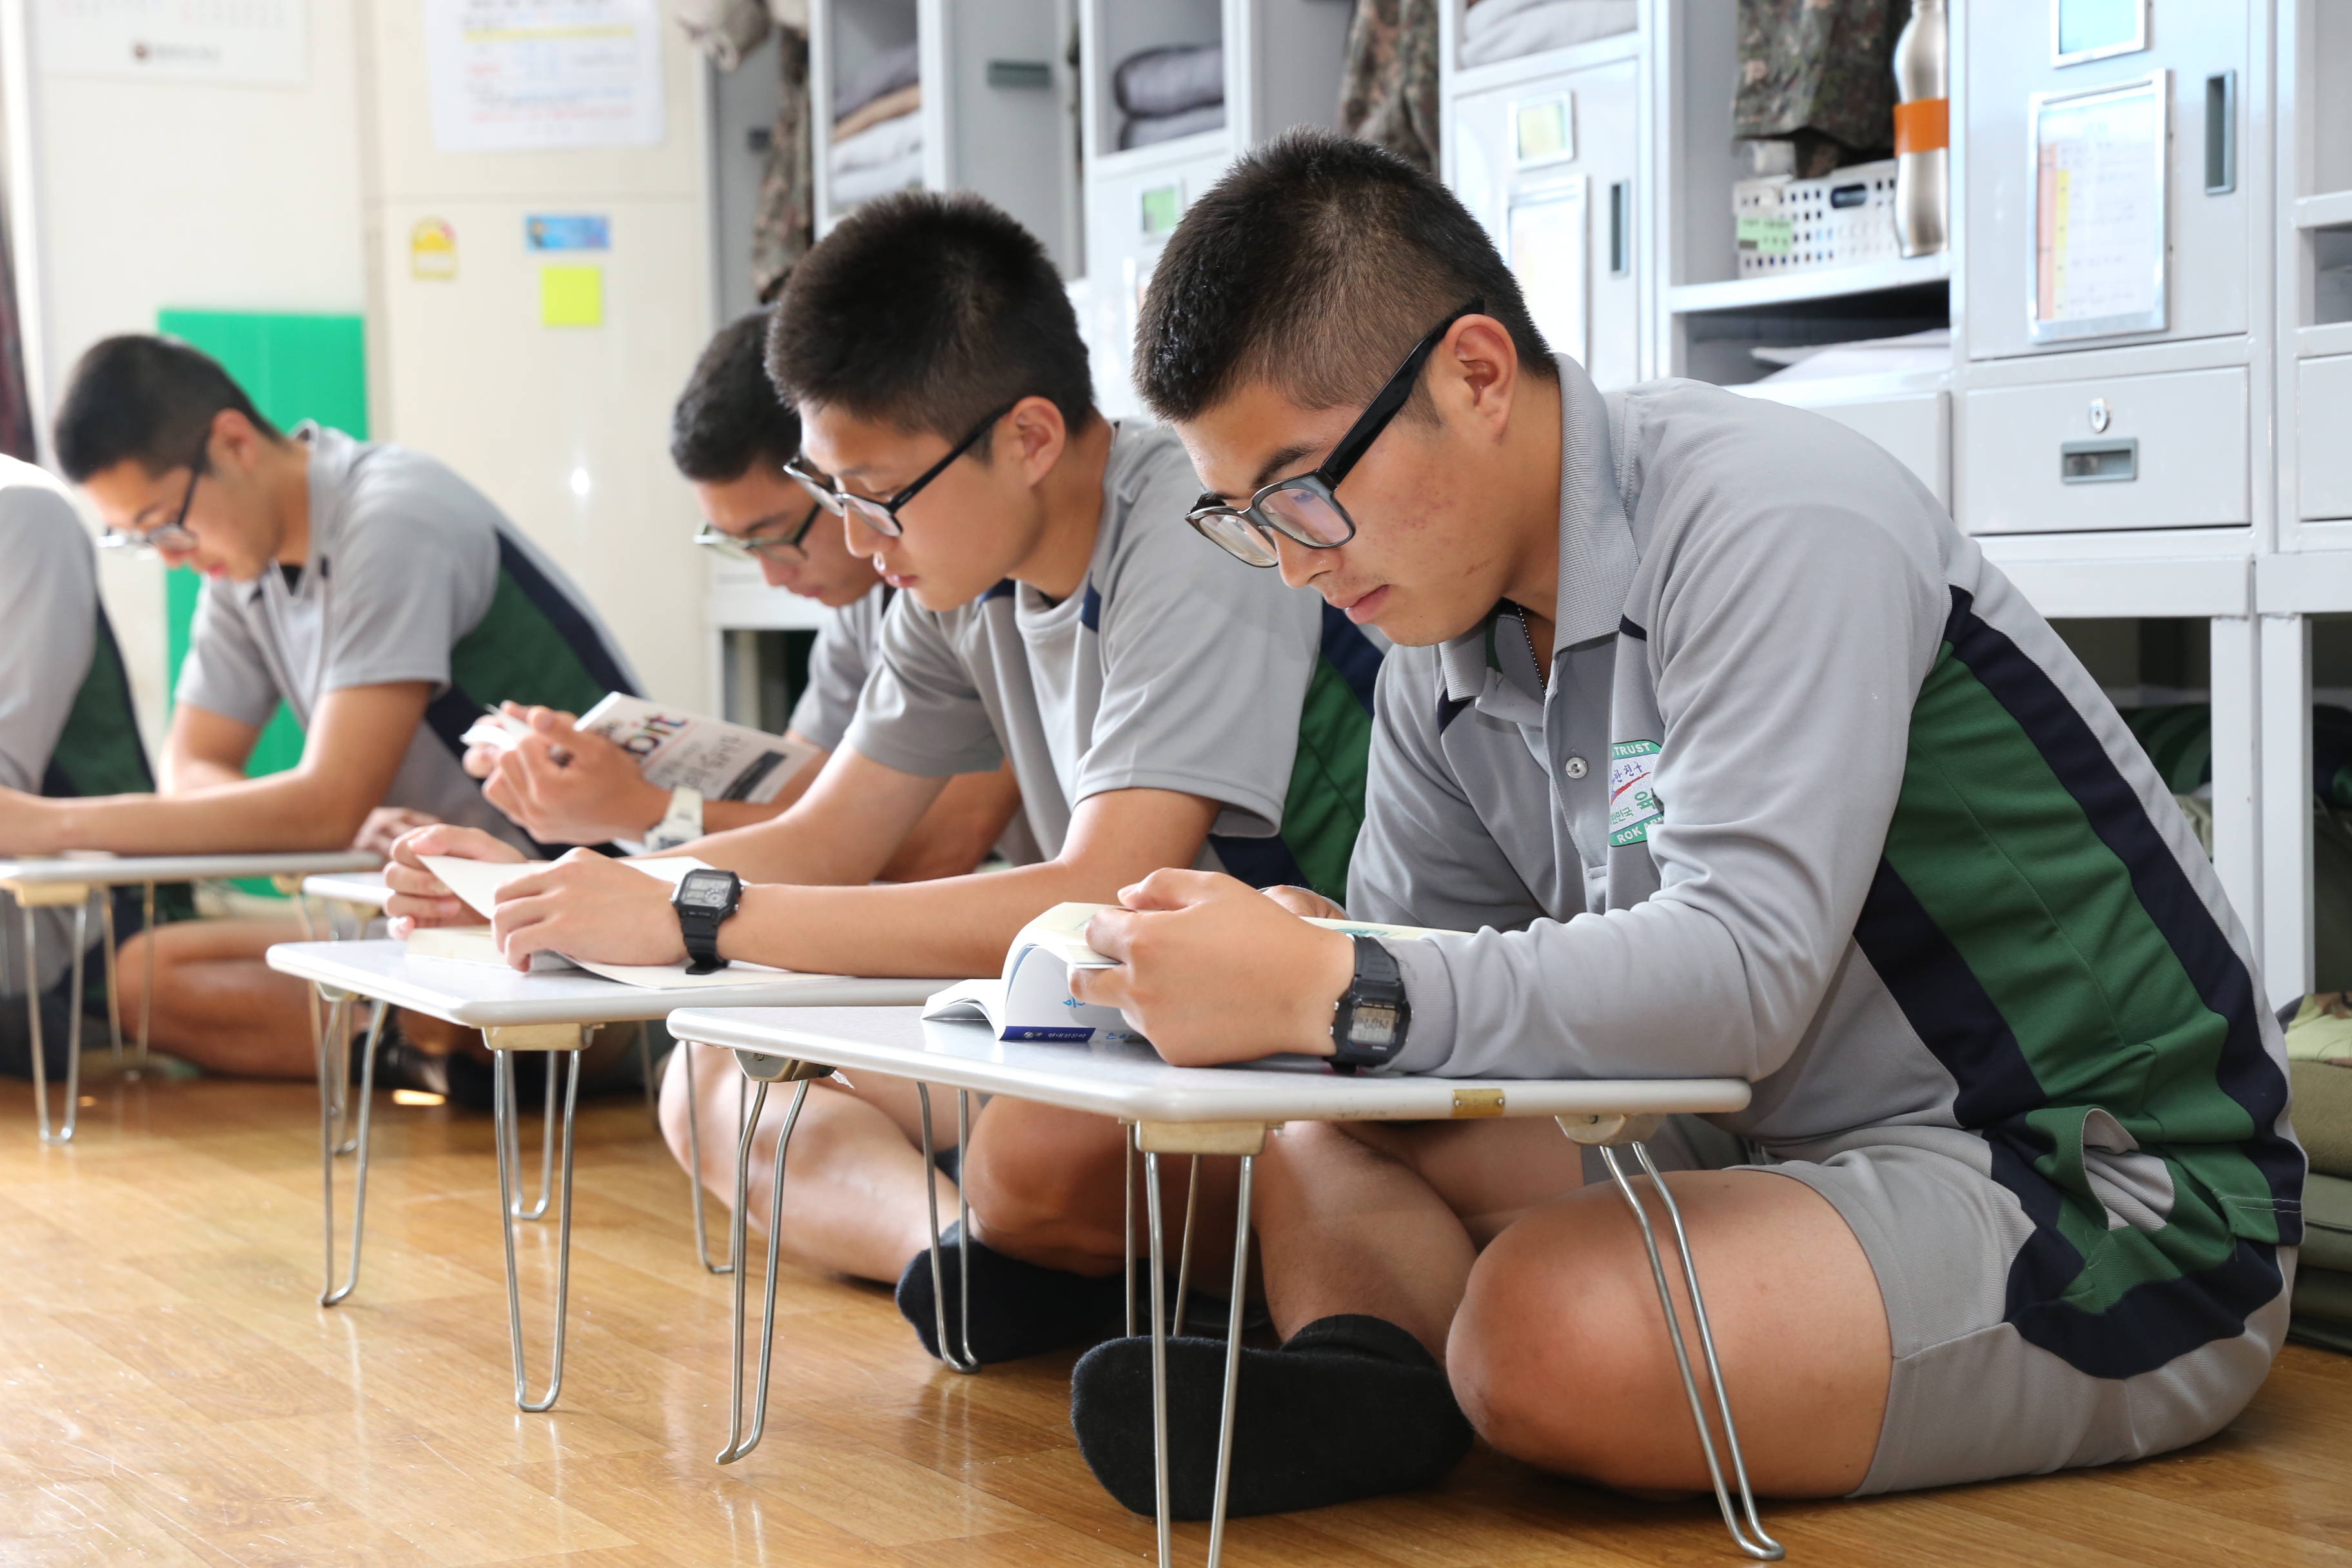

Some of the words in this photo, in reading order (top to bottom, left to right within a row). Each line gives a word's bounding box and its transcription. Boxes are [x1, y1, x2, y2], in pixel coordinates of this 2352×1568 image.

[1623, 762, 1642, 776] 친구
[1610, 807, 1634, 824] 한민국
[1616, 826, 1643, 843] ROK
